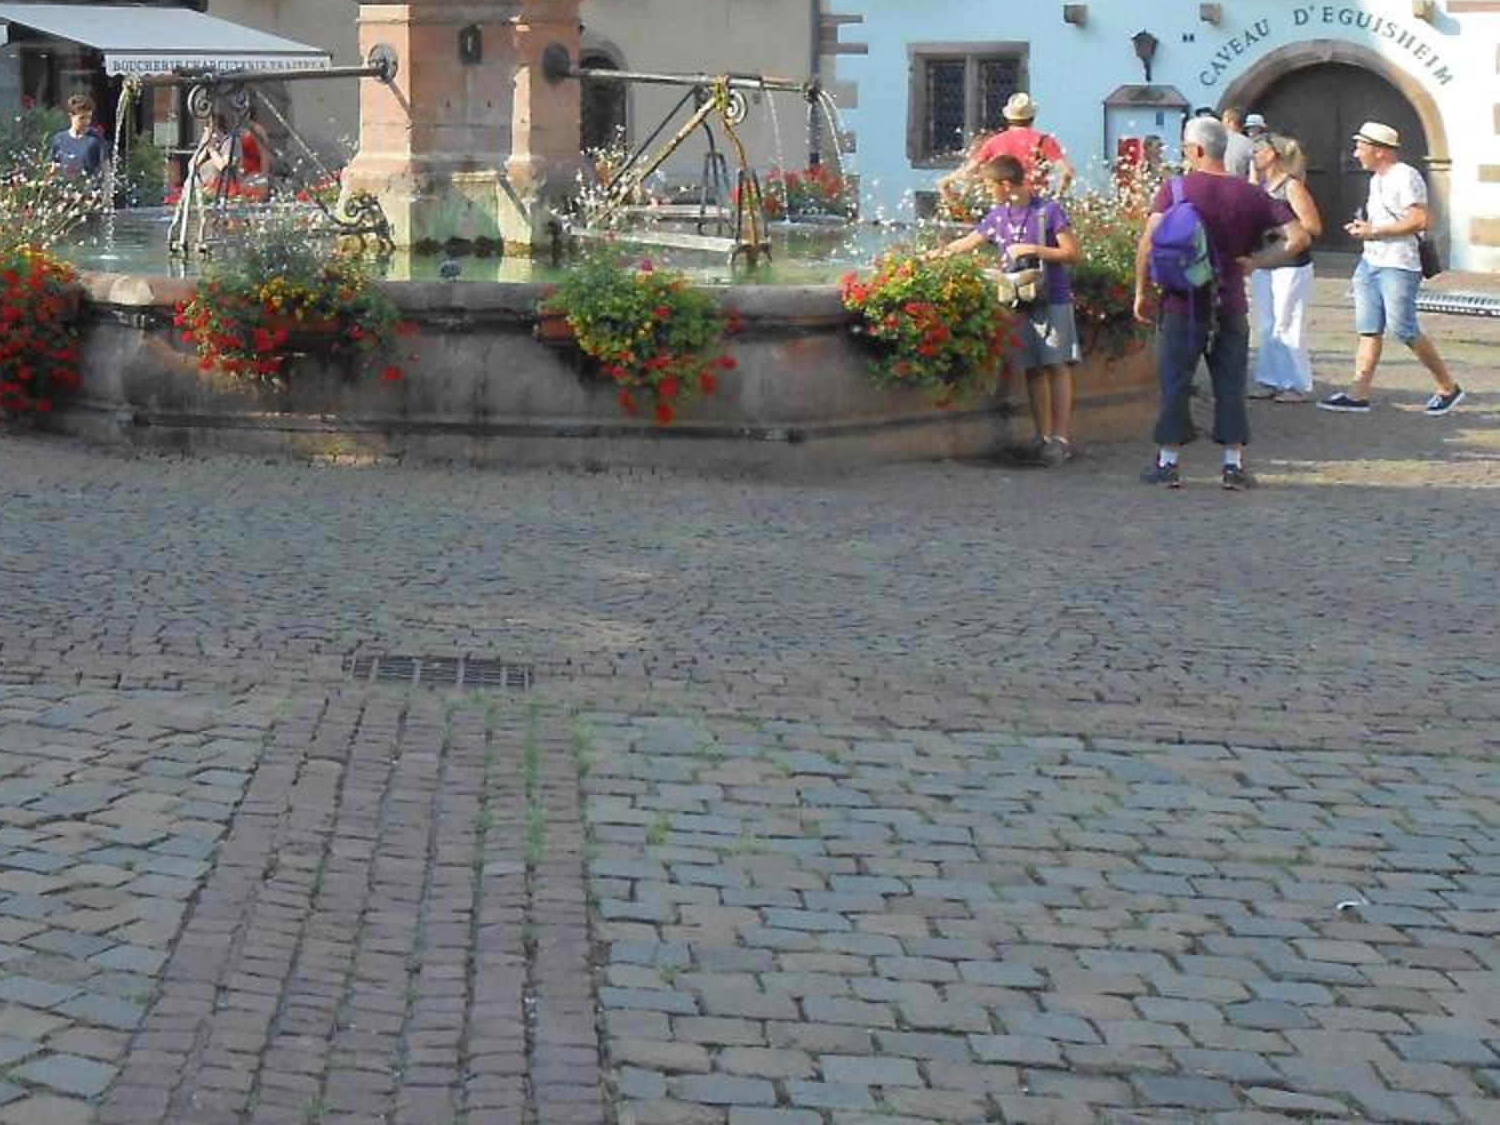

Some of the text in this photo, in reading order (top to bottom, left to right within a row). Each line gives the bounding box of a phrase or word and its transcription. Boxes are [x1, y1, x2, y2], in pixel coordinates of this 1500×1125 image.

[112, 59, 183, 72] BOUCHERIE
[1199, 5, 1454, 87] CAVEAU D'EGUISHEIM
